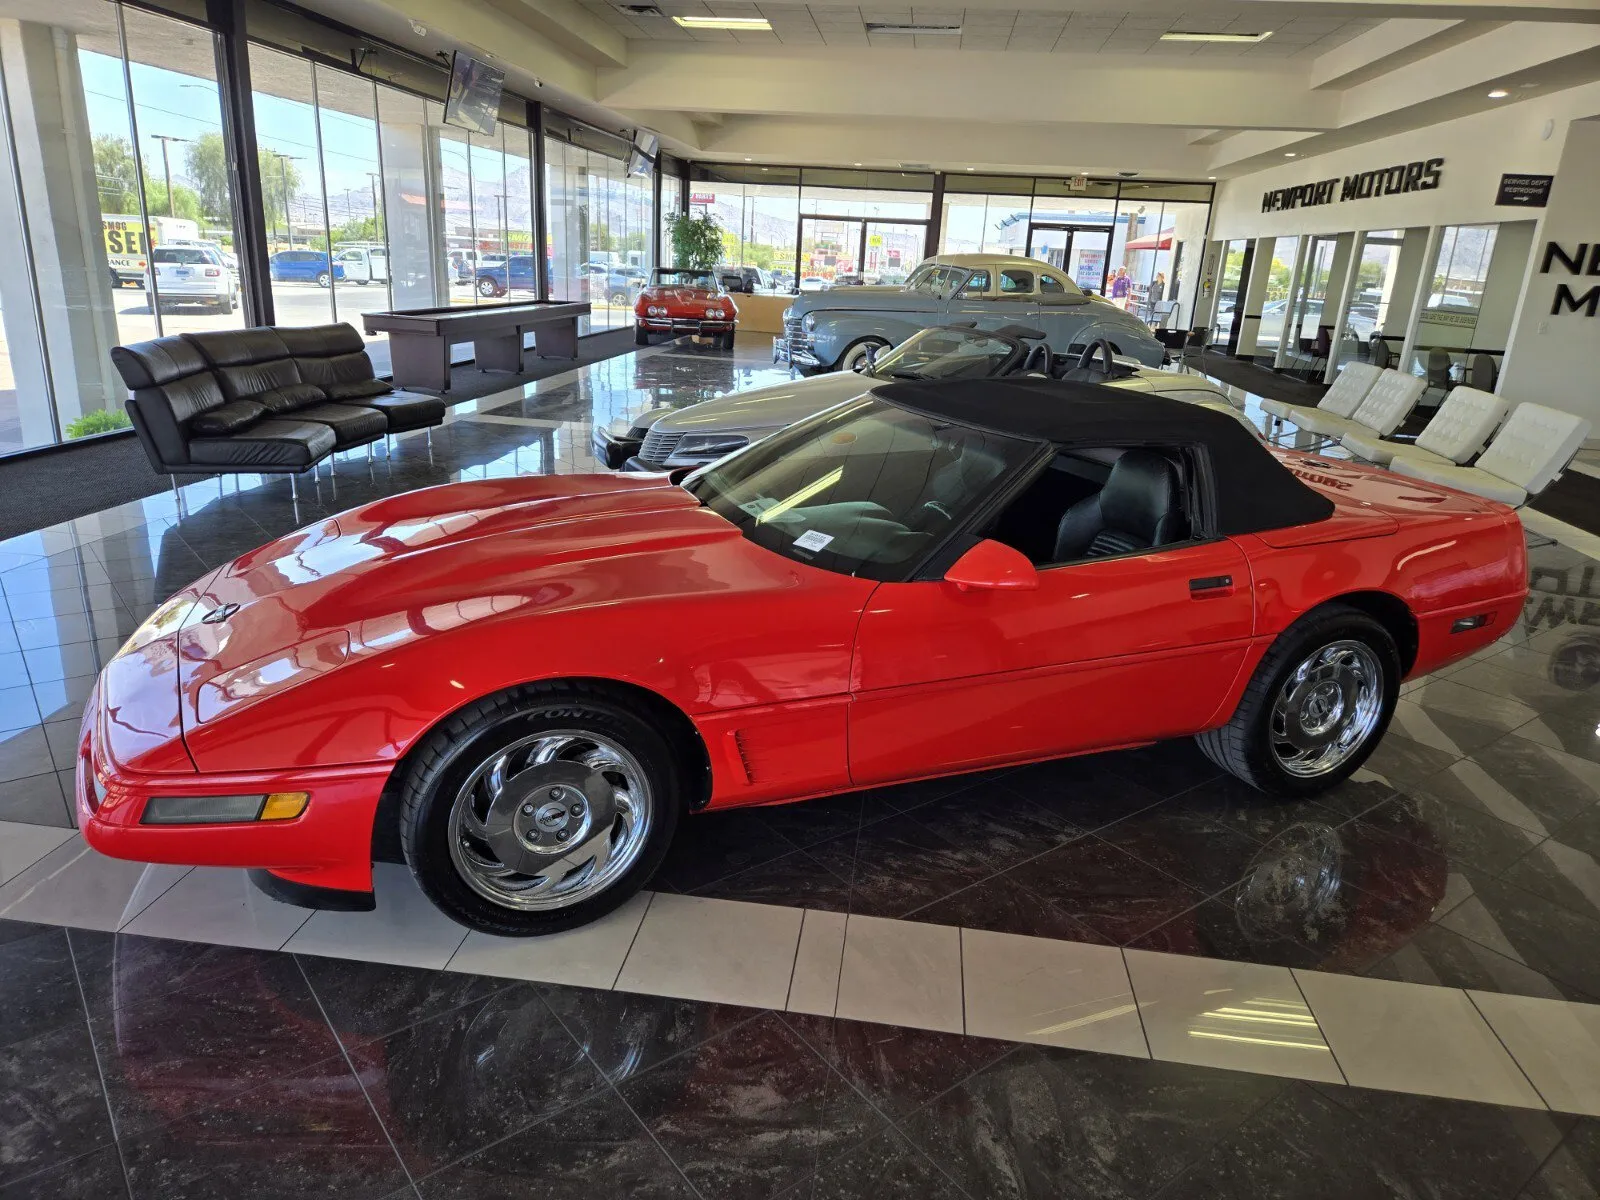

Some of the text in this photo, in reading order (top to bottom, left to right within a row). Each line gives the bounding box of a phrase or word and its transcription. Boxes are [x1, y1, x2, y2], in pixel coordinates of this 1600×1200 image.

[1261, 157, 1445, 213] NEWPORT MOTORS
[102, 221, 127, 231] SMOG
